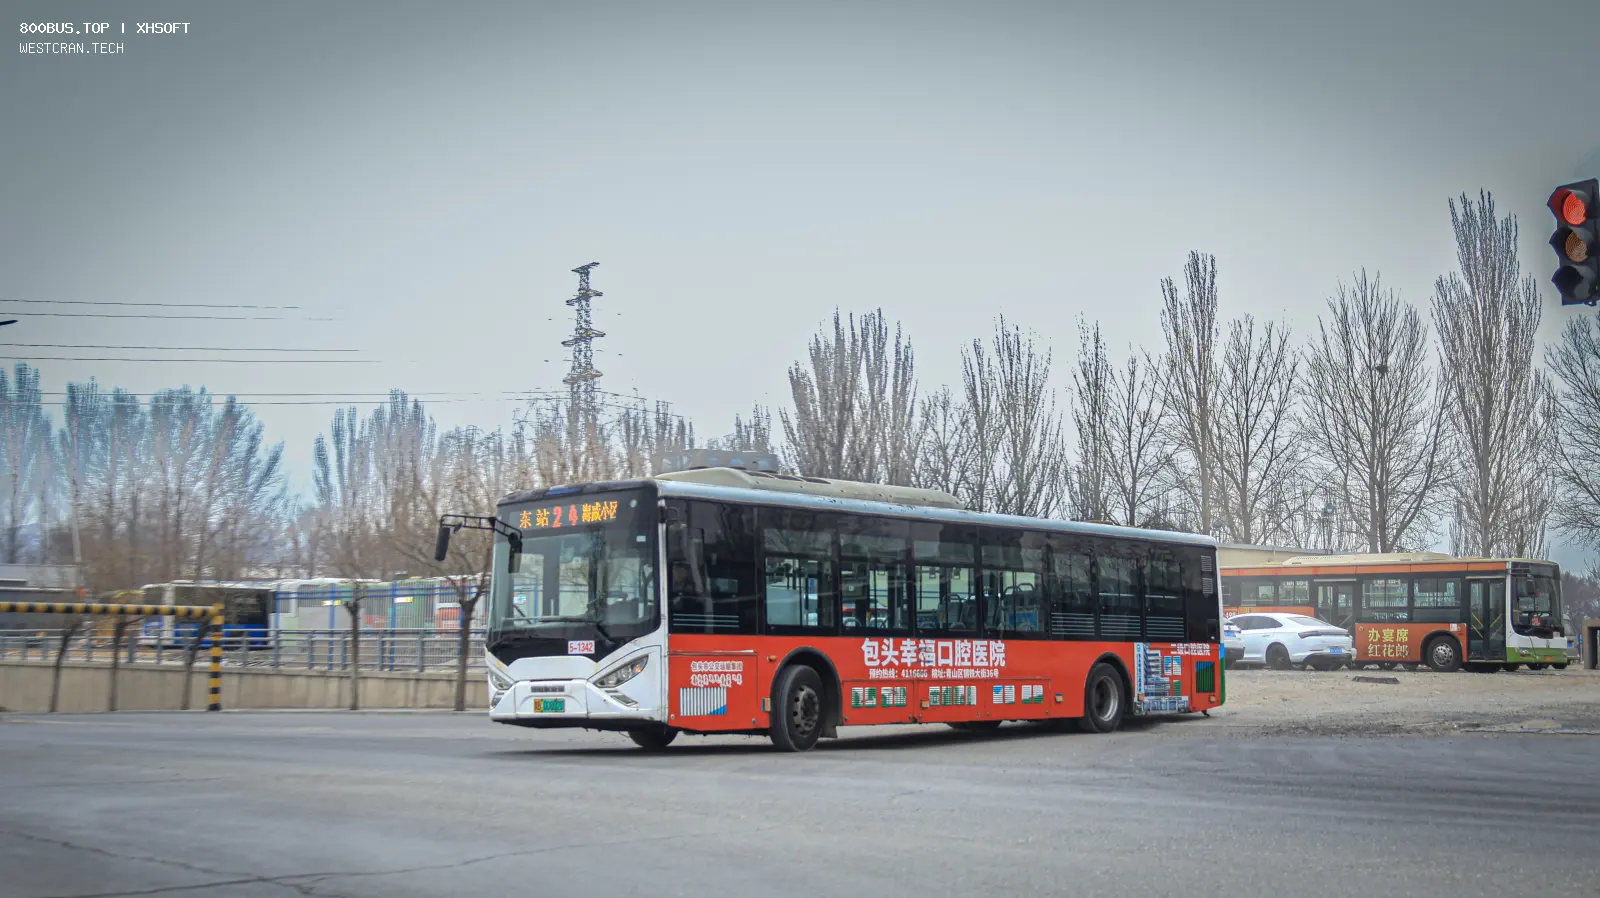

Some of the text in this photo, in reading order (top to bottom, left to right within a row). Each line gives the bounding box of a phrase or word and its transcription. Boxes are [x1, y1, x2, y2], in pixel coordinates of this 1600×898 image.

[552, 504, 578, 528] 24
[1368, 628, 1409, 643] 办宴席
[569, 642, 593, 653] 5-1342
[861, 638, 1006, 667] 包头幸福口腔医院
[1368, 643, 1409, 658] 红花郎
